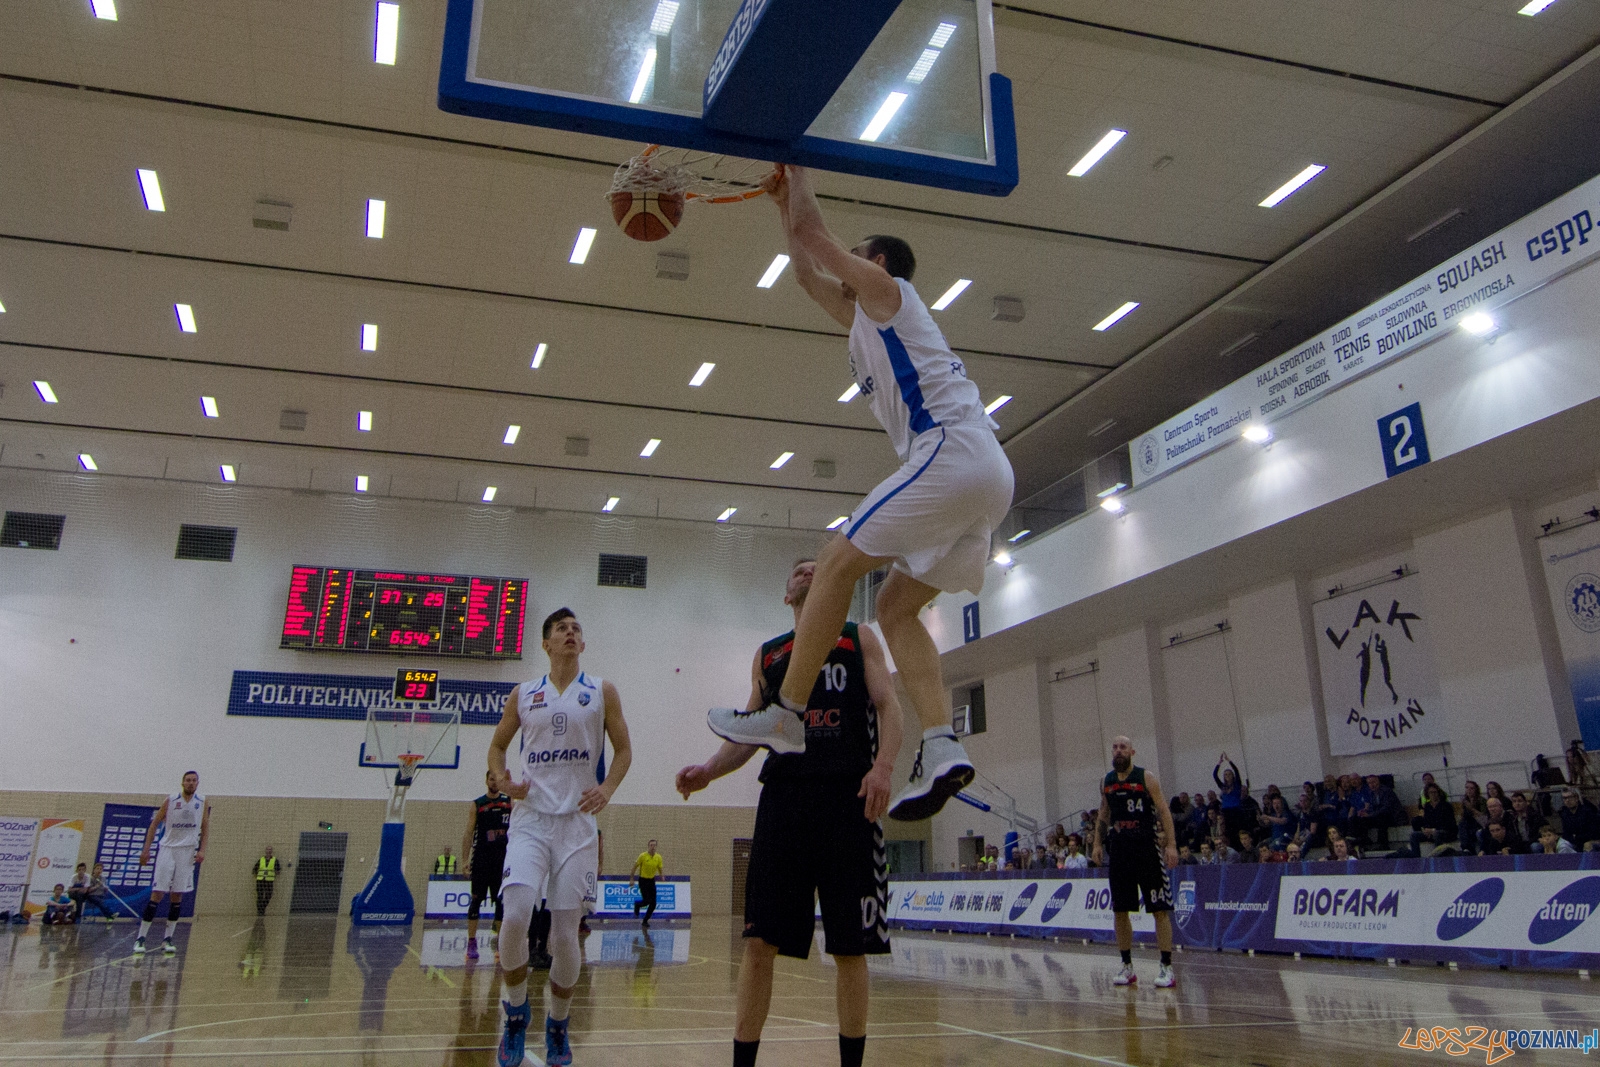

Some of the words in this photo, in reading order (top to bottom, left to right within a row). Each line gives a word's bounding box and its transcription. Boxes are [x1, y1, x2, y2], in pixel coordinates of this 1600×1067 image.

[1437, 240, 1507, 294] SQUASH
[1443, 274, 1515, 320] ERGOWIOSŁA
[1385, 300, 1428, 330] SIŁOWNIA
[1331, 326, 1351, 346] JUDO
[1376, 311, 1437, 355] BOWLING
[1334, 333, 1371, 363] TENIS
[1256, 367, 1279, 387] HALA
[1279, 341, 1325, 375] SPORTOWA
[1305, 357, 1326, 375] SZACHY
[1342, 356, 1364, 372] KARATE
[1293, 370, 1331, 399] AEROBIK
[1260, 395, 1287, 416] BOISKA
[1164, 421, 1193, 442] Centrum
[1194, 406, 1219, 427] Sportu
[1166, 432, 1206, 461] Politechniki
[1207, 407, 1252, 439] Poznańskiej
[1389, 415, 1417, 467] 2
[380, 590, 402, 605] 37
[423, 592, 445, 607] 25
[967, 608, 975, 638] 1
[821, 662, 848, 692] 10
[404, 683, 428, 698] 23
[551, 712, 568, 736] 9
[1347, 698, 1425, 740] POZNAŃ
[527, 748, 590, 764] BIOFARM
[1126, 798, 1144, 813] 84
[953, 894, 966, 911] PBG
[971, 894, 984, 911] PBG
[989, 894, 1003, 912] PBG
[1150, 887, 1166, 903] 84
[1293, 887, 1400, 918] BIOFARM
[1447, 899, 1491, 918] atrem
[1540, 899, 1590, 920] atrem
[1299, 920, 1320, 929] POLSKI
[1323, 921, 1361, 930] PRODUCENT
[1364, 922, 1388, 931] LEKÓW
